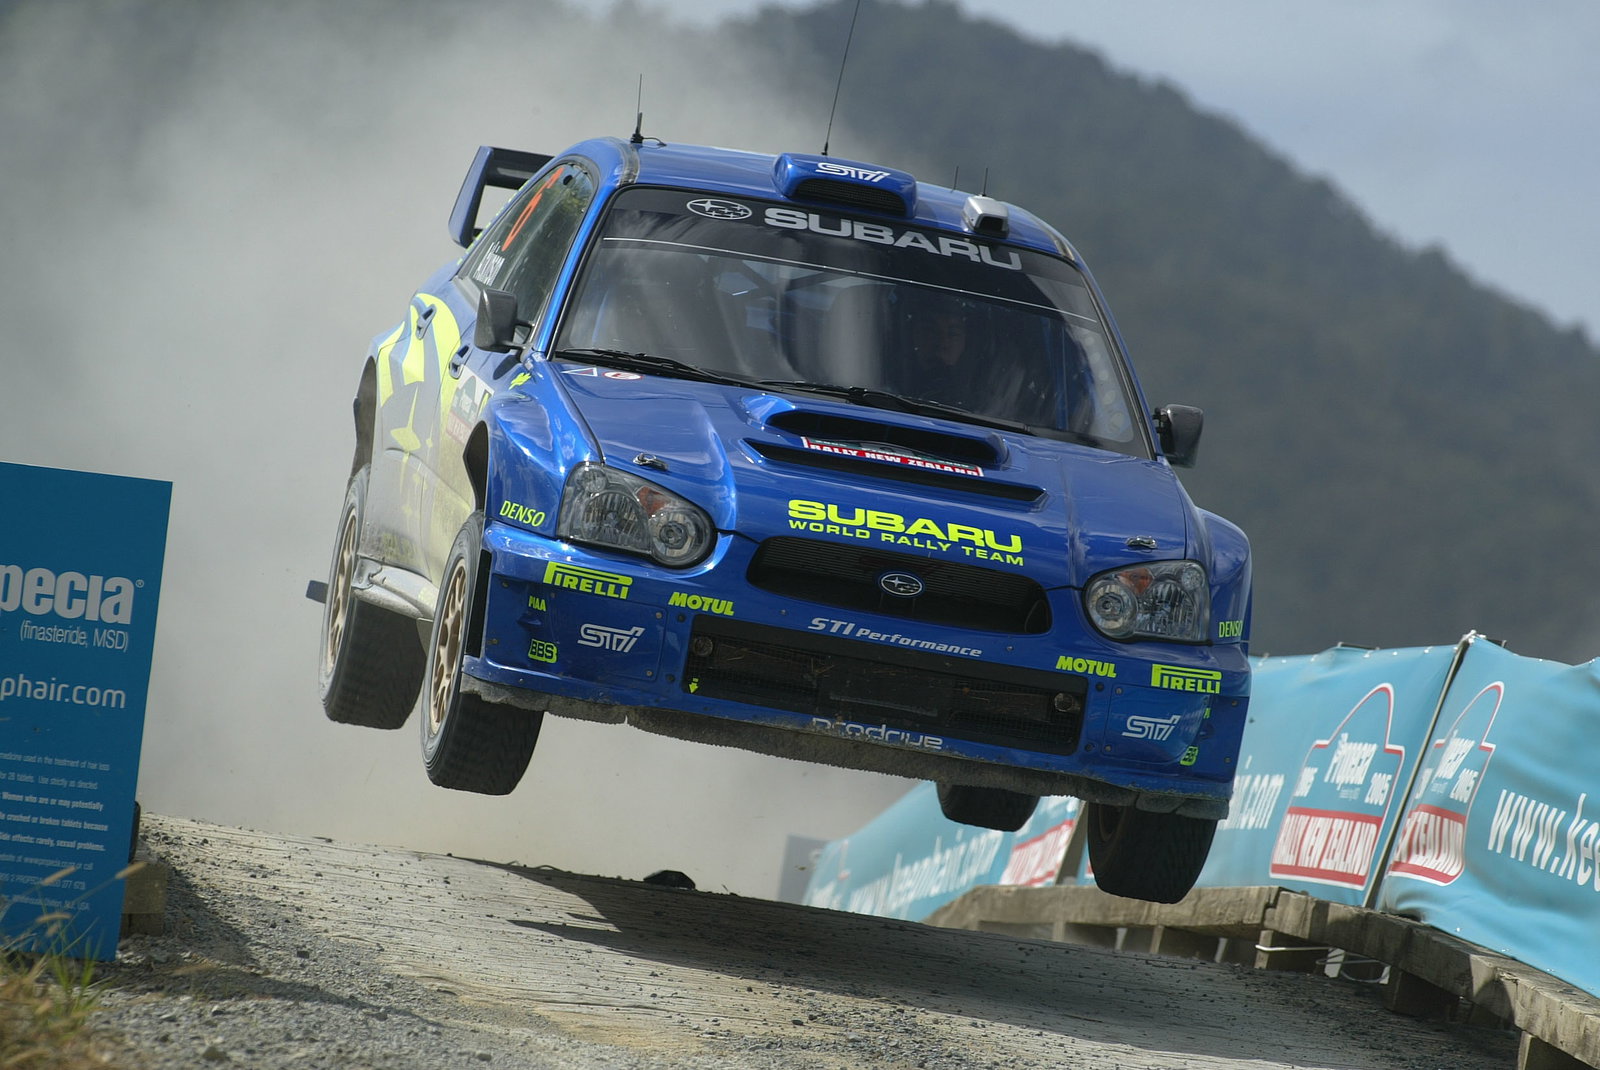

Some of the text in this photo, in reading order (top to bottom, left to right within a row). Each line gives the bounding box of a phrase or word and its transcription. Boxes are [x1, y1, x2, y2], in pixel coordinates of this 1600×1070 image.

[764, 206, 1023, 271] SUBARU
[809, 443, 979, 476] RALLY NEW ZEALAND
[499, 500, 546, 527] DENSO
[788, 498, 1023, 554] SUBARU
[788, 519, 1024, 567] WORLD RALLY TEAM
[542, 560, 633, 600] PIRELLI
[528, 595, 547, 612] PIAA
[668, 591, 734, 617] MOTUL
[20, 619, 129, 653] (finasteride, MSD)
[529, 640, 556, 661] BBS
[808, 617, 983, 658] STI Performance
[1056, 655, 1117, 678] MOTUL
[1150, 664, 1222, 694] PIRELLI
[1320, 817, 1377, 876] ZEALAND
